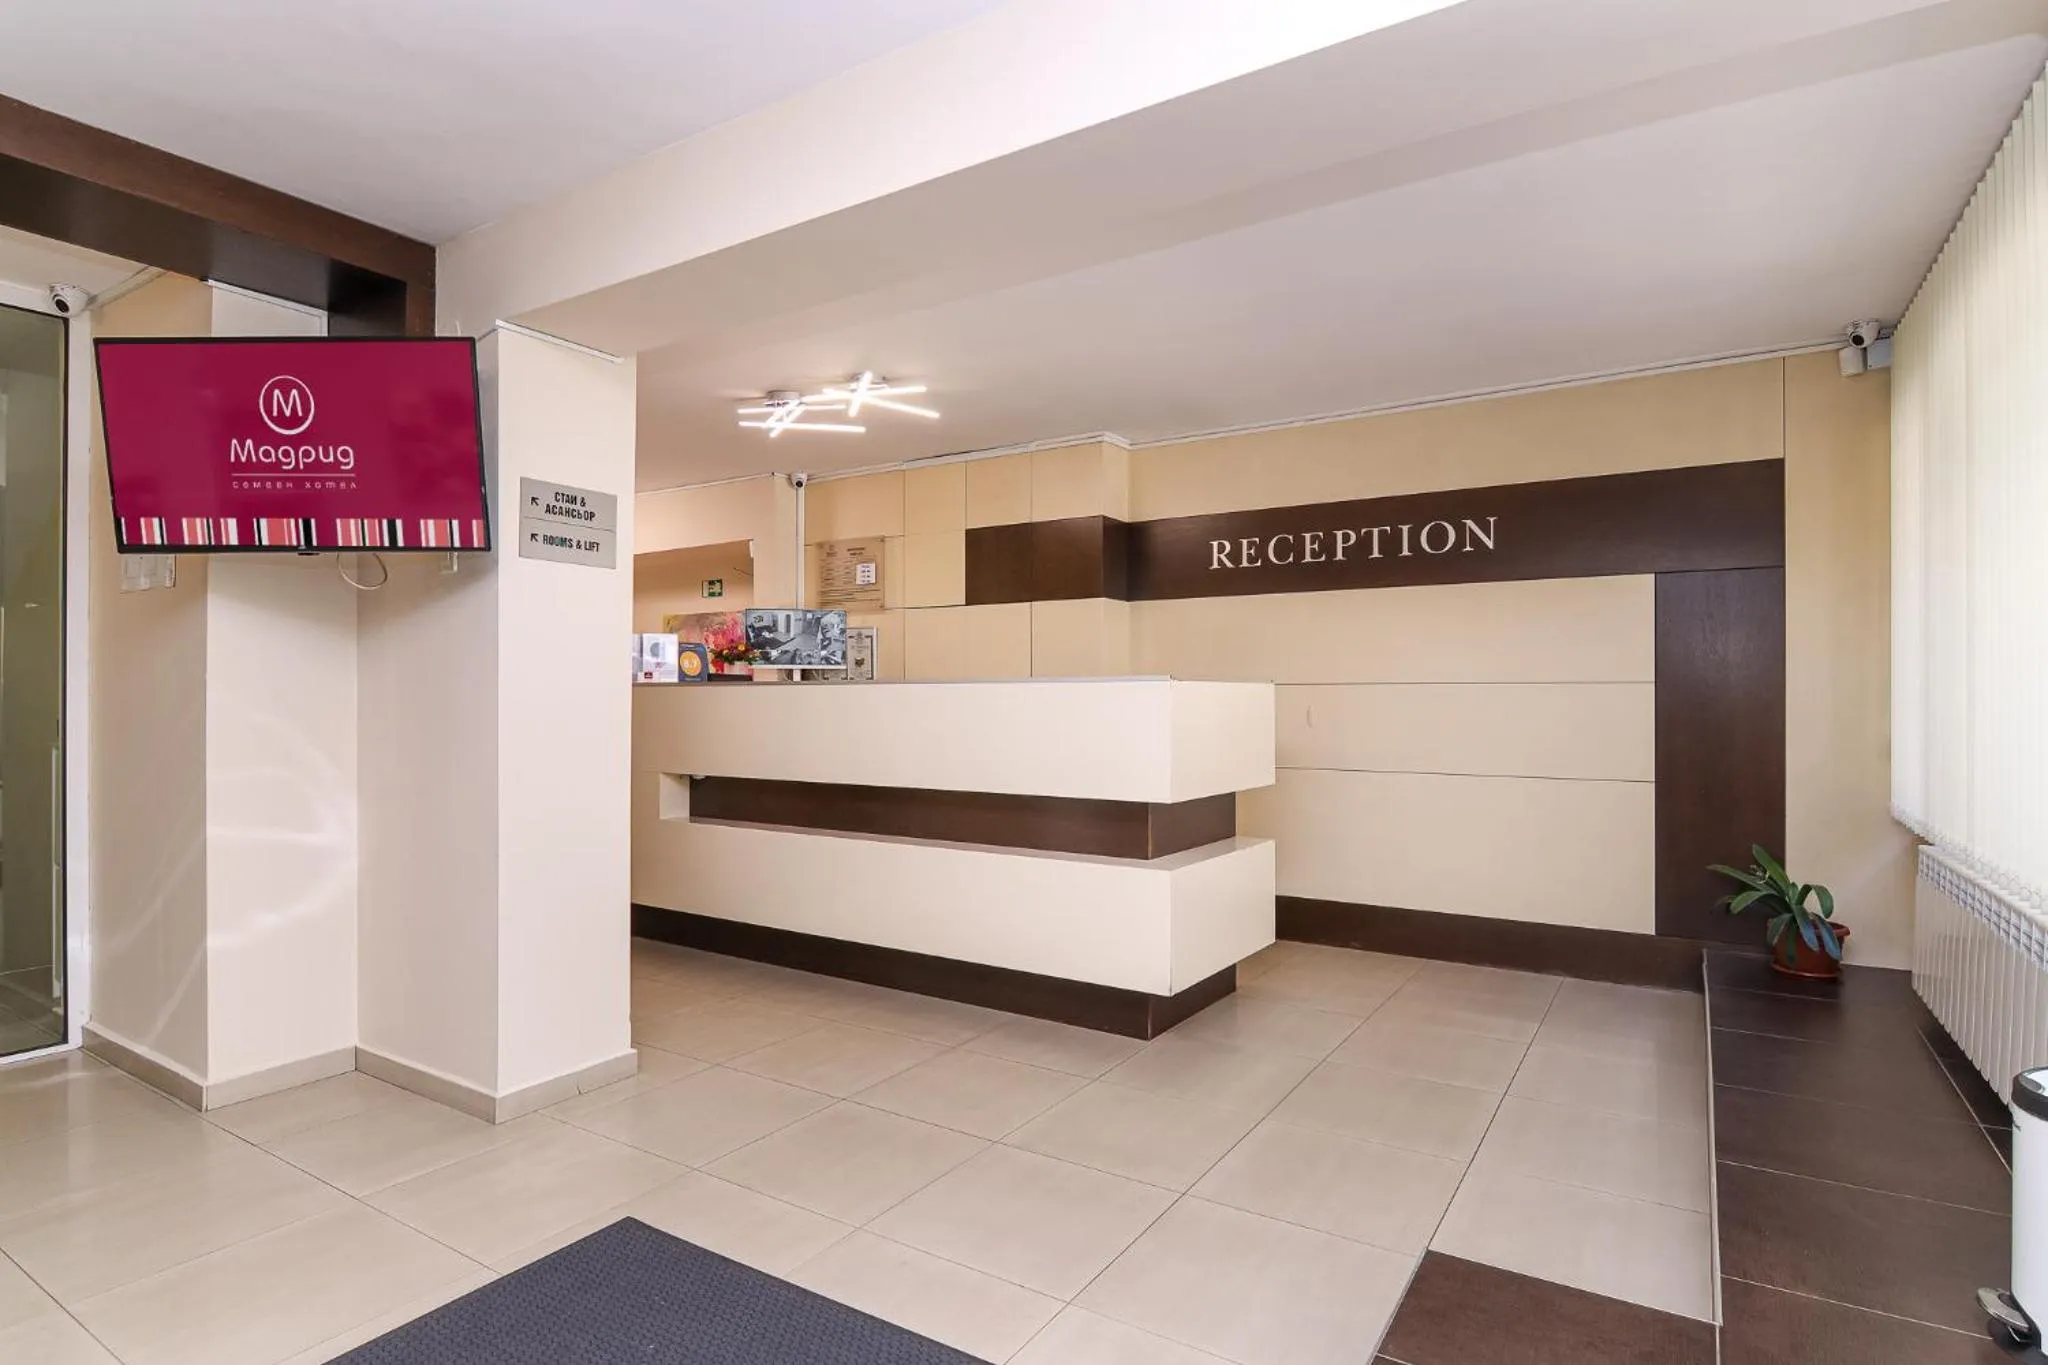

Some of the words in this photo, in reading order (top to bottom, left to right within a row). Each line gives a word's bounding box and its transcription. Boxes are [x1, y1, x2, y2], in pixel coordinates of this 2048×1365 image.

[554, 491, 577, 506] СТАИ
[580, 496, 586, 507] &
[544, 503, 596, 521] АСАНСЬОР
[542, 534, 573, 549] ROOMS
[575, 539, 582, 550] &
[584, 540, 600, 552] LIFT
[1209, 516, 1498, 570] RECEPTION
